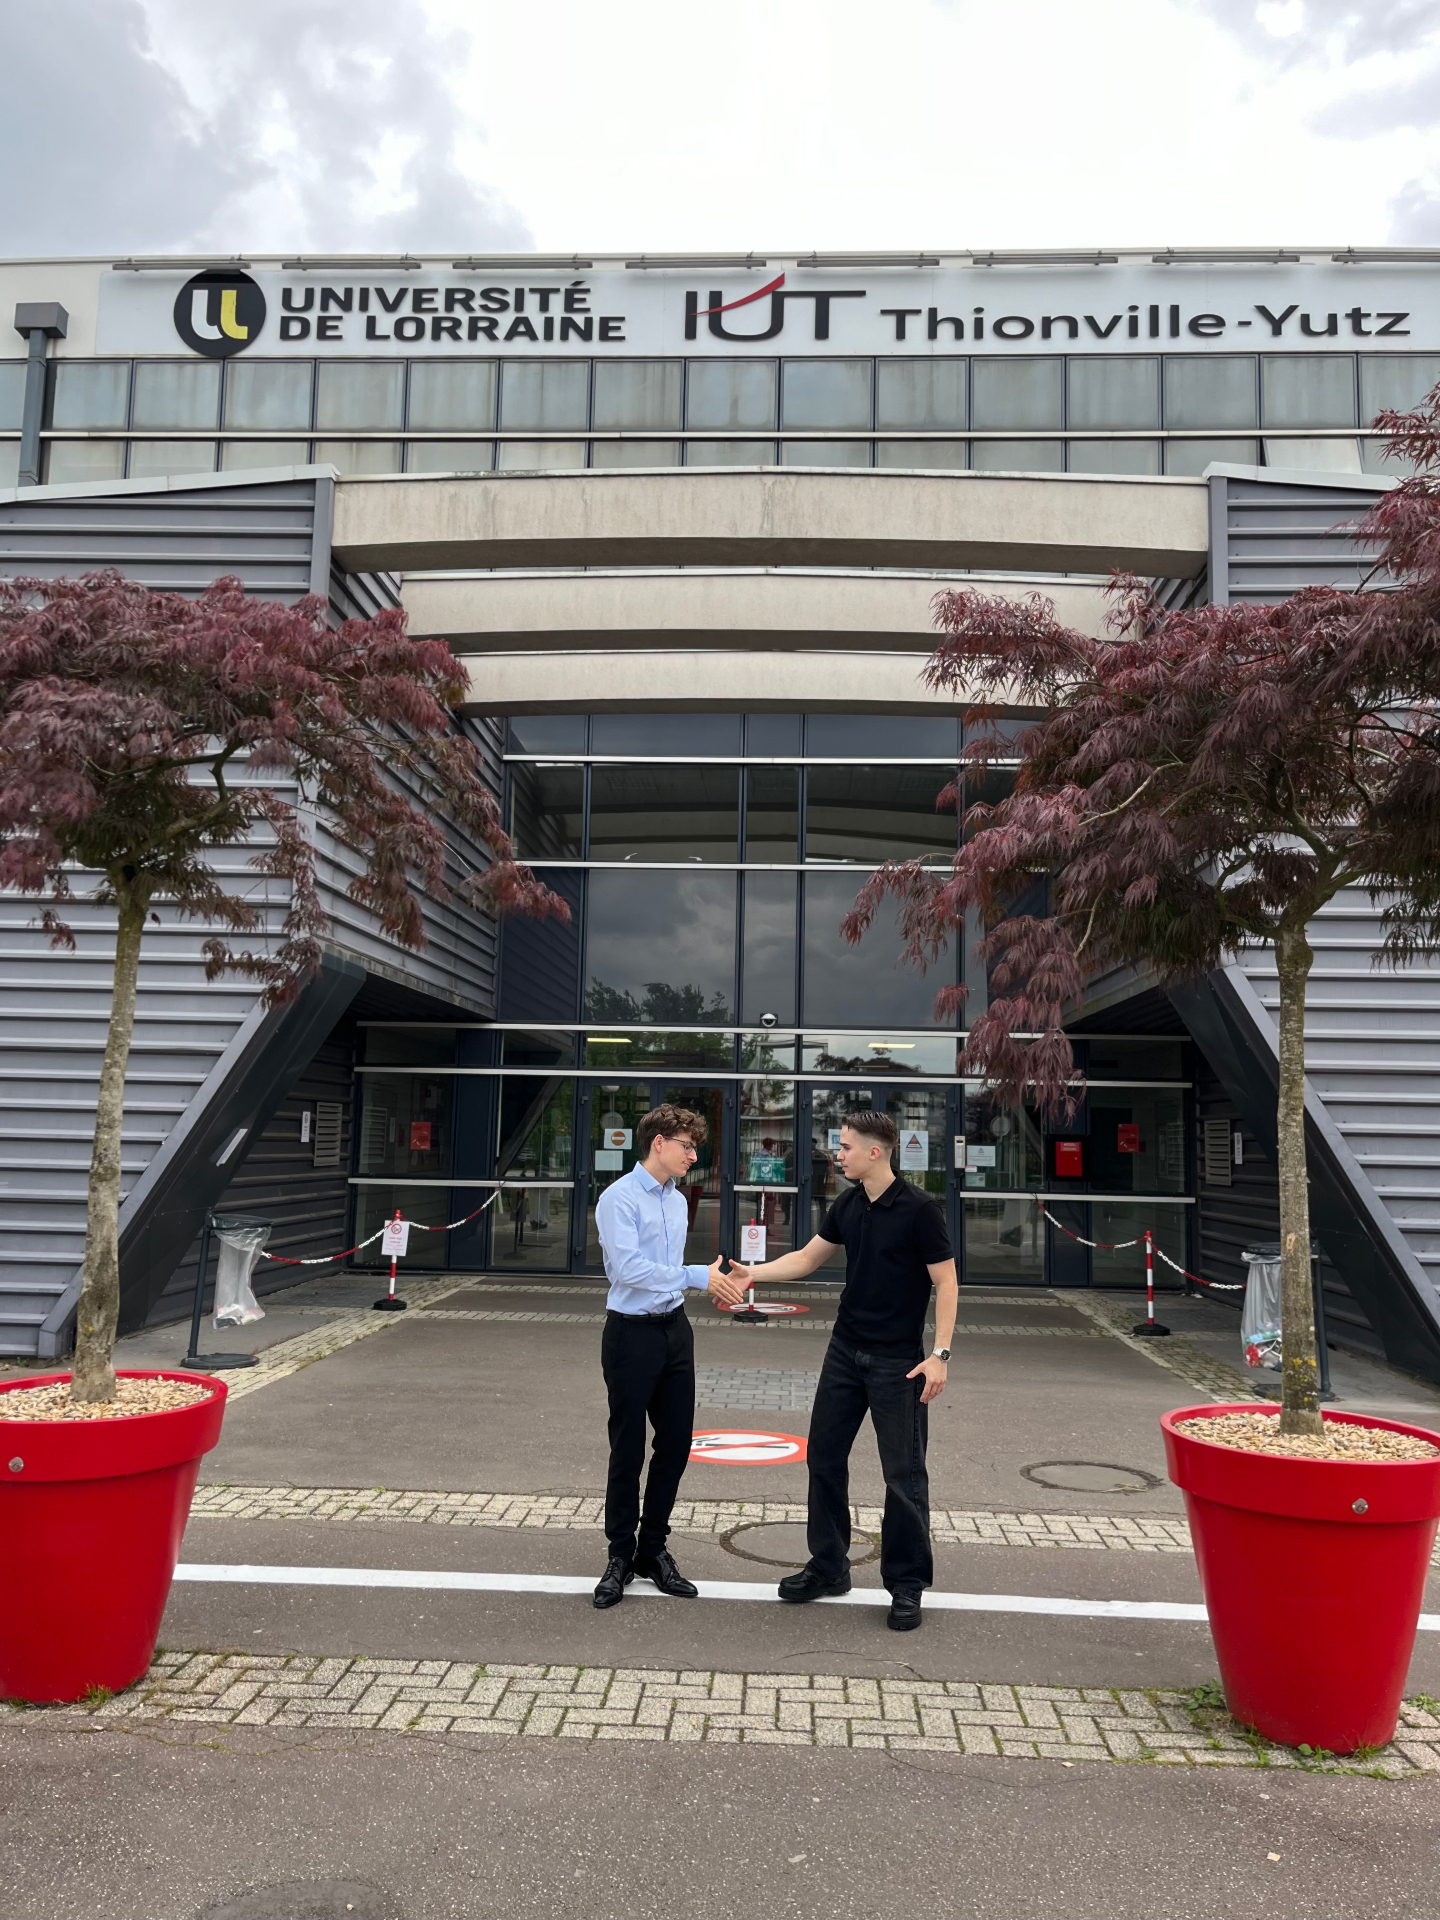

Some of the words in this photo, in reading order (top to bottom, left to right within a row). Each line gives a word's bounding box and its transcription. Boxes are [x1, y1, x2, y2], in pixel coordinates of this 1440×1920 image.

[281, 280, 592, 313] UNIVERSITÉ
[279, 315, 344, 341] DE
[365, 315, 626, 342] LORRAINE
[684, 288, 867, 341] IUT
[879, 304, 1412, 341] Thionville-Yutz
